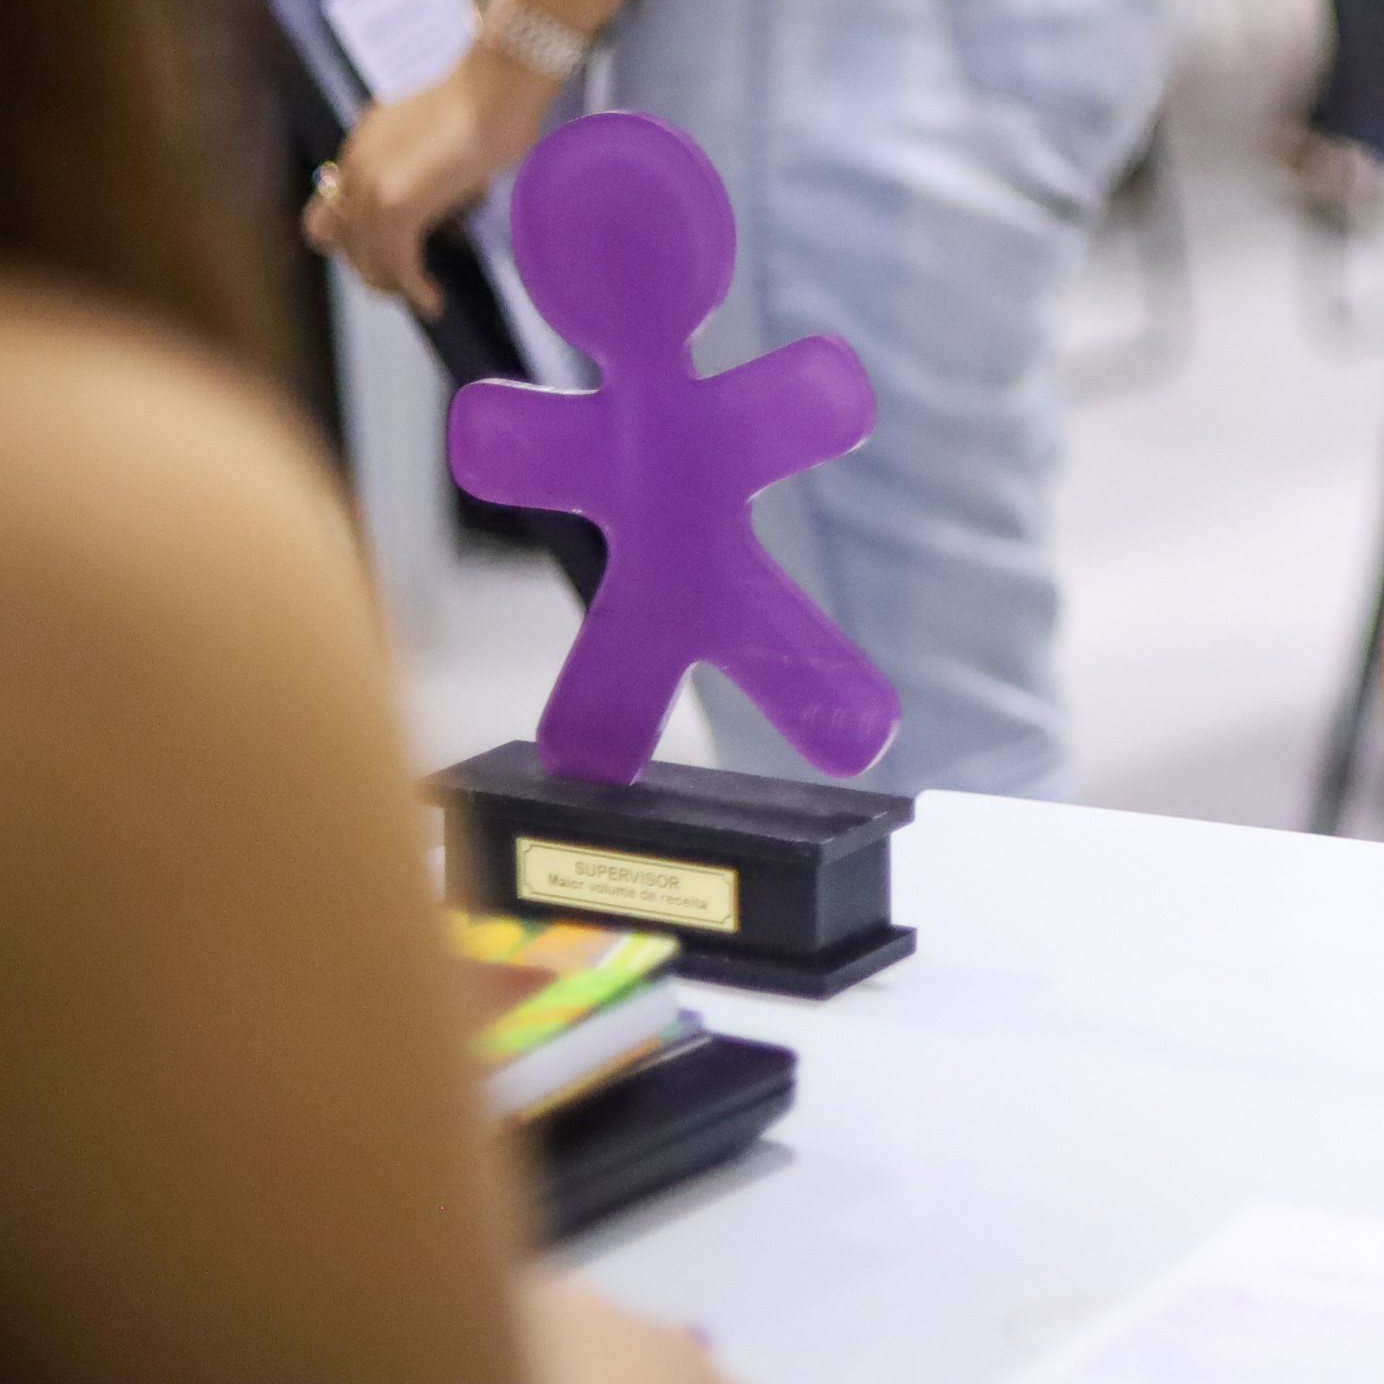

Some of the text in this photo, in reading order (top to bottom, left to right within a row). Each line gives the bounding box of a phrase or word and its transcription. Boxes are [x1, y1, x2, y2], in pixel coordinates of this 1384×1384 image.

[574, 860, 680, 890] SUPERVISOR
[589, 884, 636, 899] volume
[640, 889, 657, 902] de
